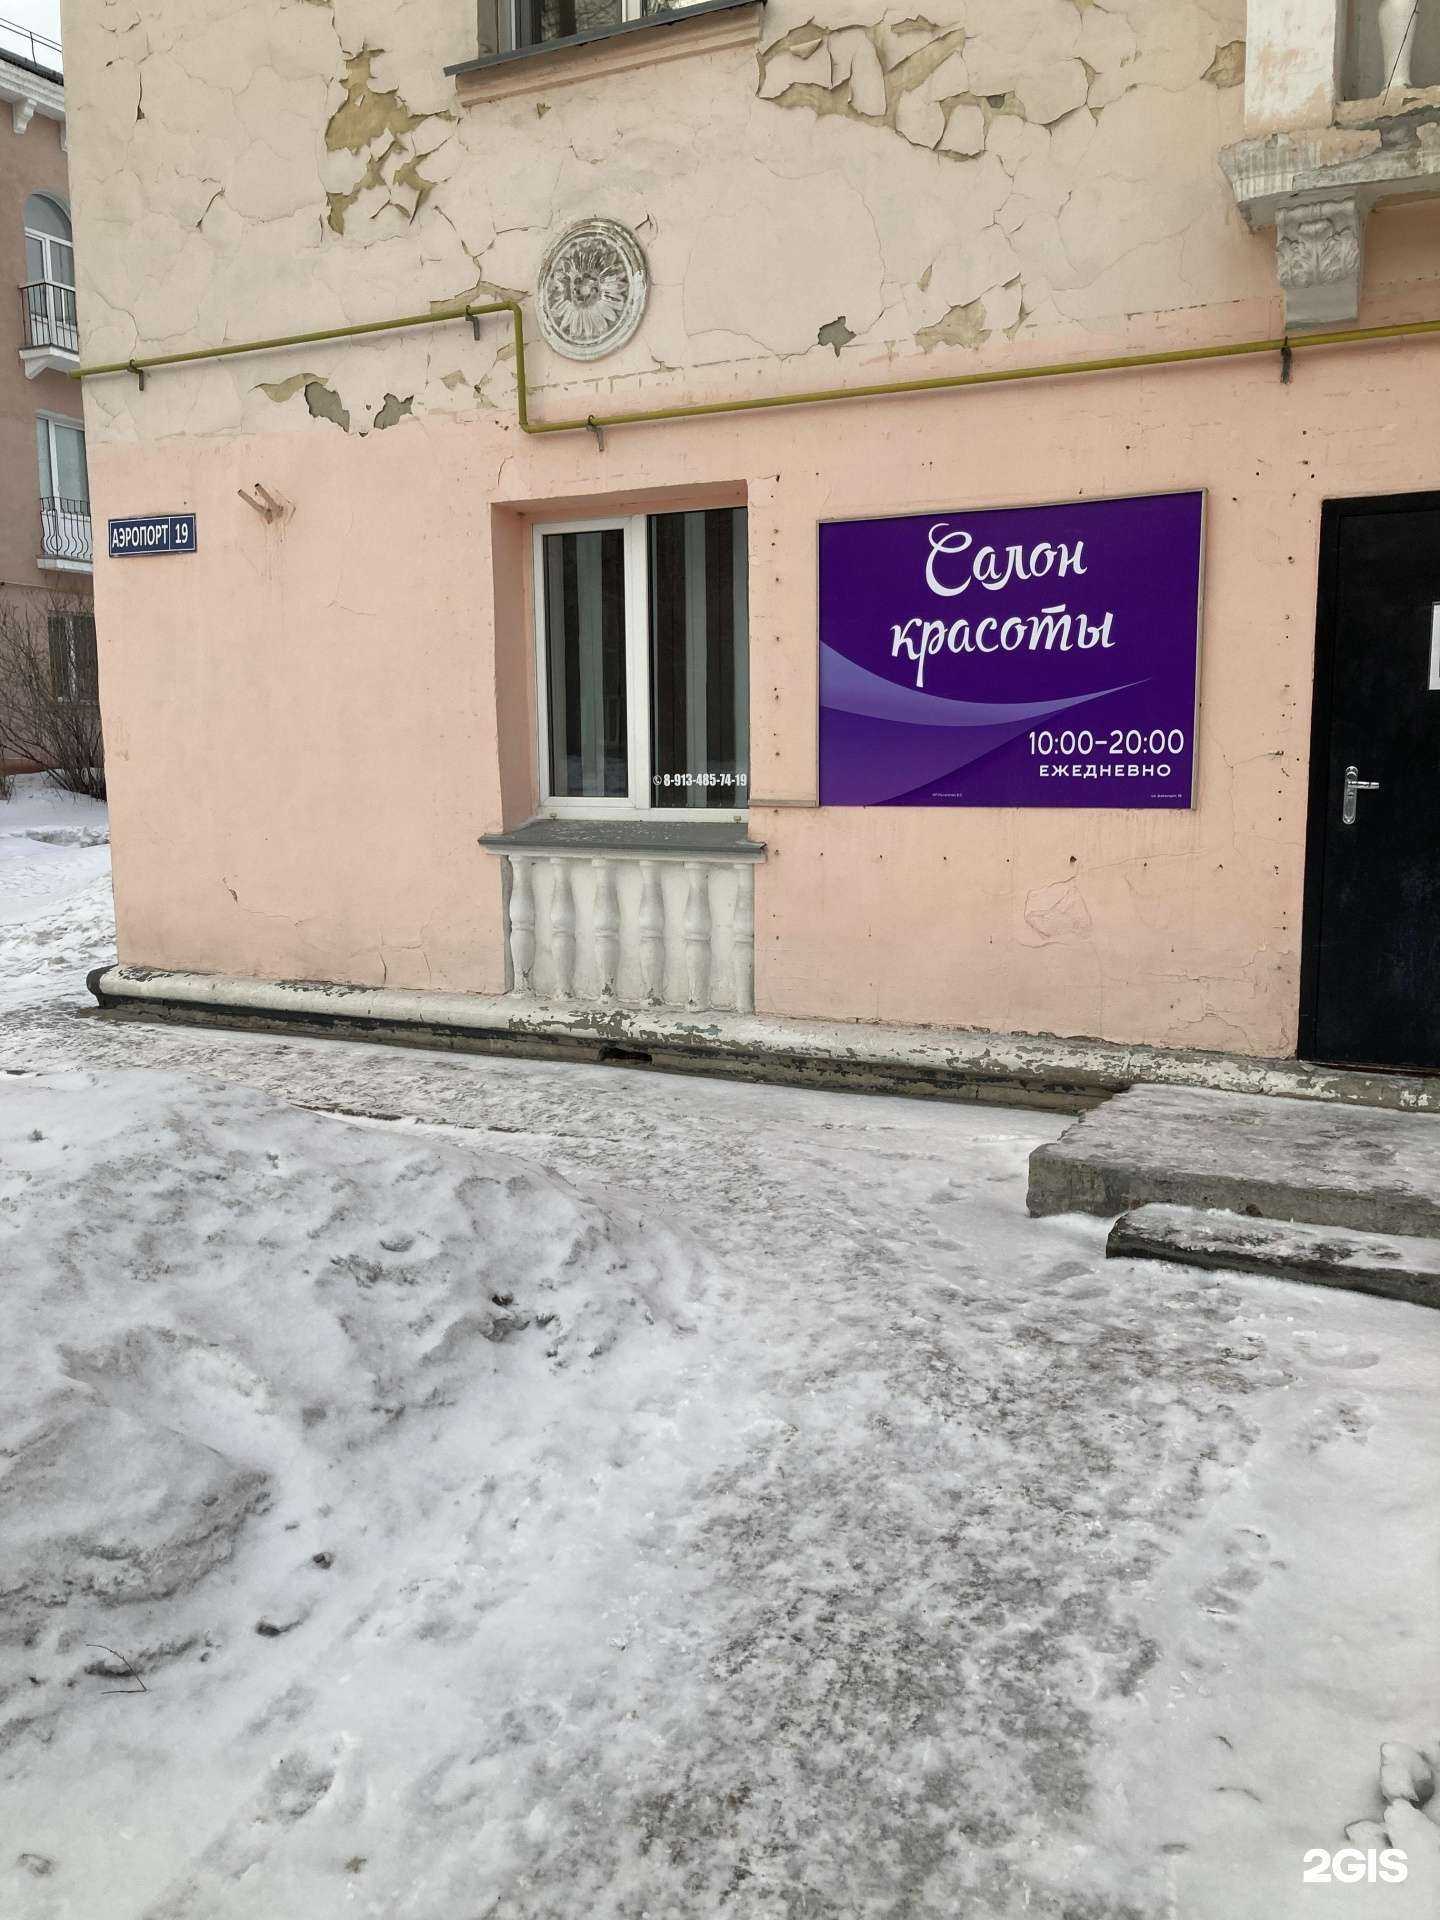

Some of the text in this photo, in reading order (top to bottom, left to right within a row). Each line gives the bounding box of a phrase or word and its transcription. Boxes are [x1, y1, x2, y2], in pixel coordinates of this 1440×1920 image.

[112, 523, 188, 548] АЭРОПОРТ 19
[925, 522, 1088, 597] Салон
[890, 603, 1116, 688] красоты
[1039, 764, 1171, 779] ЕЖЕДНЕВНО
